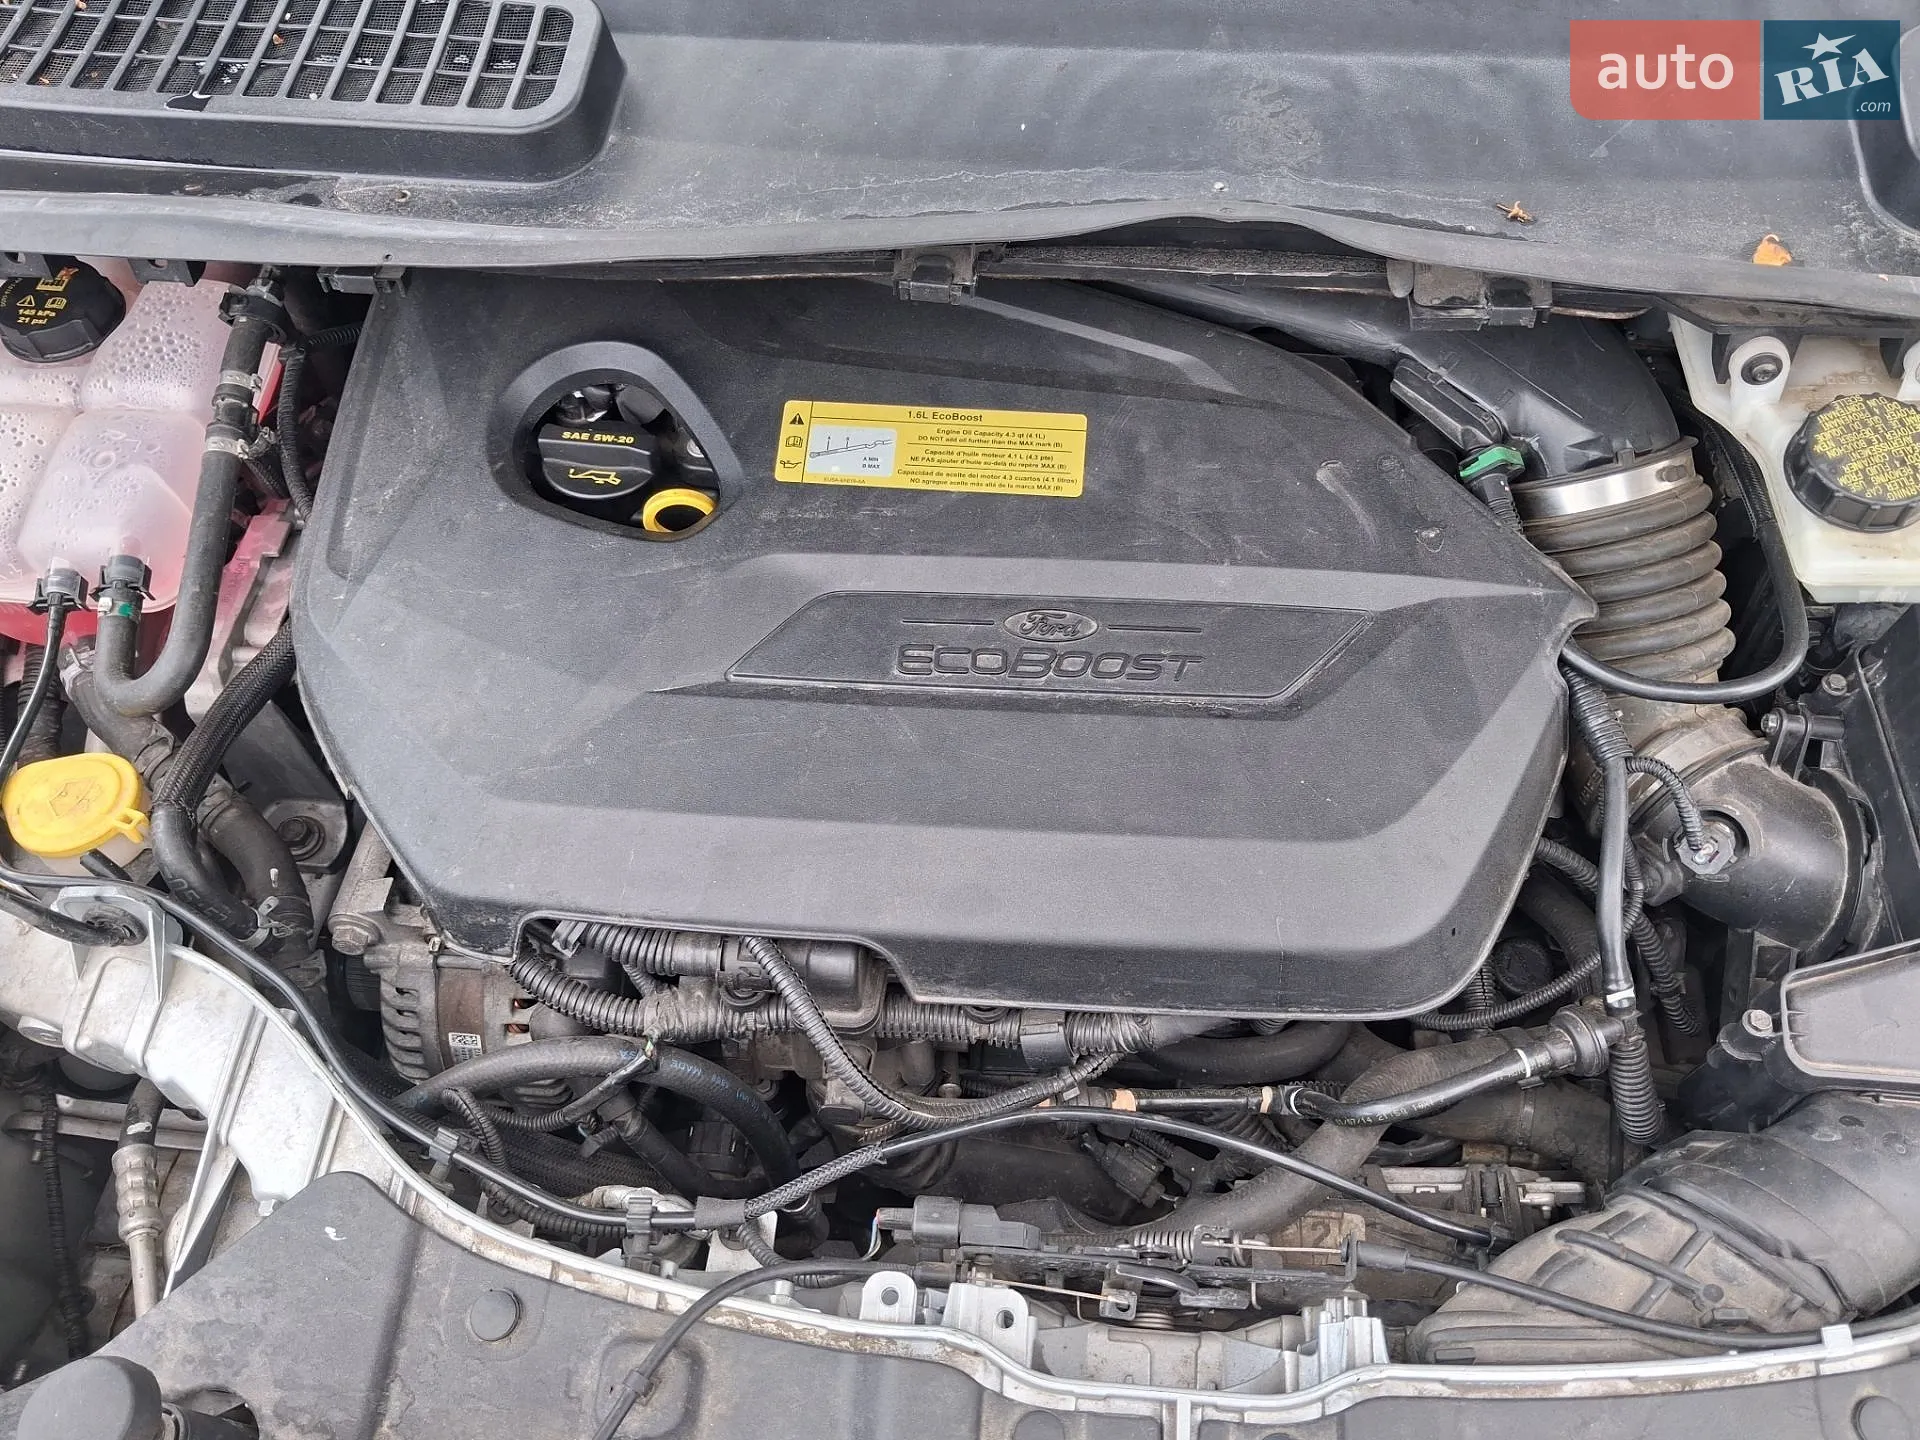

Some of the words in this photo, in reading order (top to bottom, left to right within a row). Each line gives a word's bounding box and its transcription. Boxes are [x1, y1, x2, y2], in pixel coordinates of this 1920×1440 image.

[908, 411, 928, 419] 1.6L
[932, 412, 982, 422] EcoBoost
[562, 431, 590, 440] SAE
[593, 434, 634, 444] 5W-20
[974, 430, 1004, 438] Capacity
[1868, 435, 1882, 445] LE
[1841, 453, 1889, 472] CONTAINER
[1866, 462, 1890, 475] FLUID
[1837, 470, 1863, 486] FROM
[1870, 466, 1913, 484] REMOVING
[1847, 480, 1866, 492] USE
[1885, 474, 1914, 490] FILLER
[1865, 486, 1882, 497] CAP
[1886, 484, 1920, 500] ARNING
[1018, 611, 1080, 638] Ford
